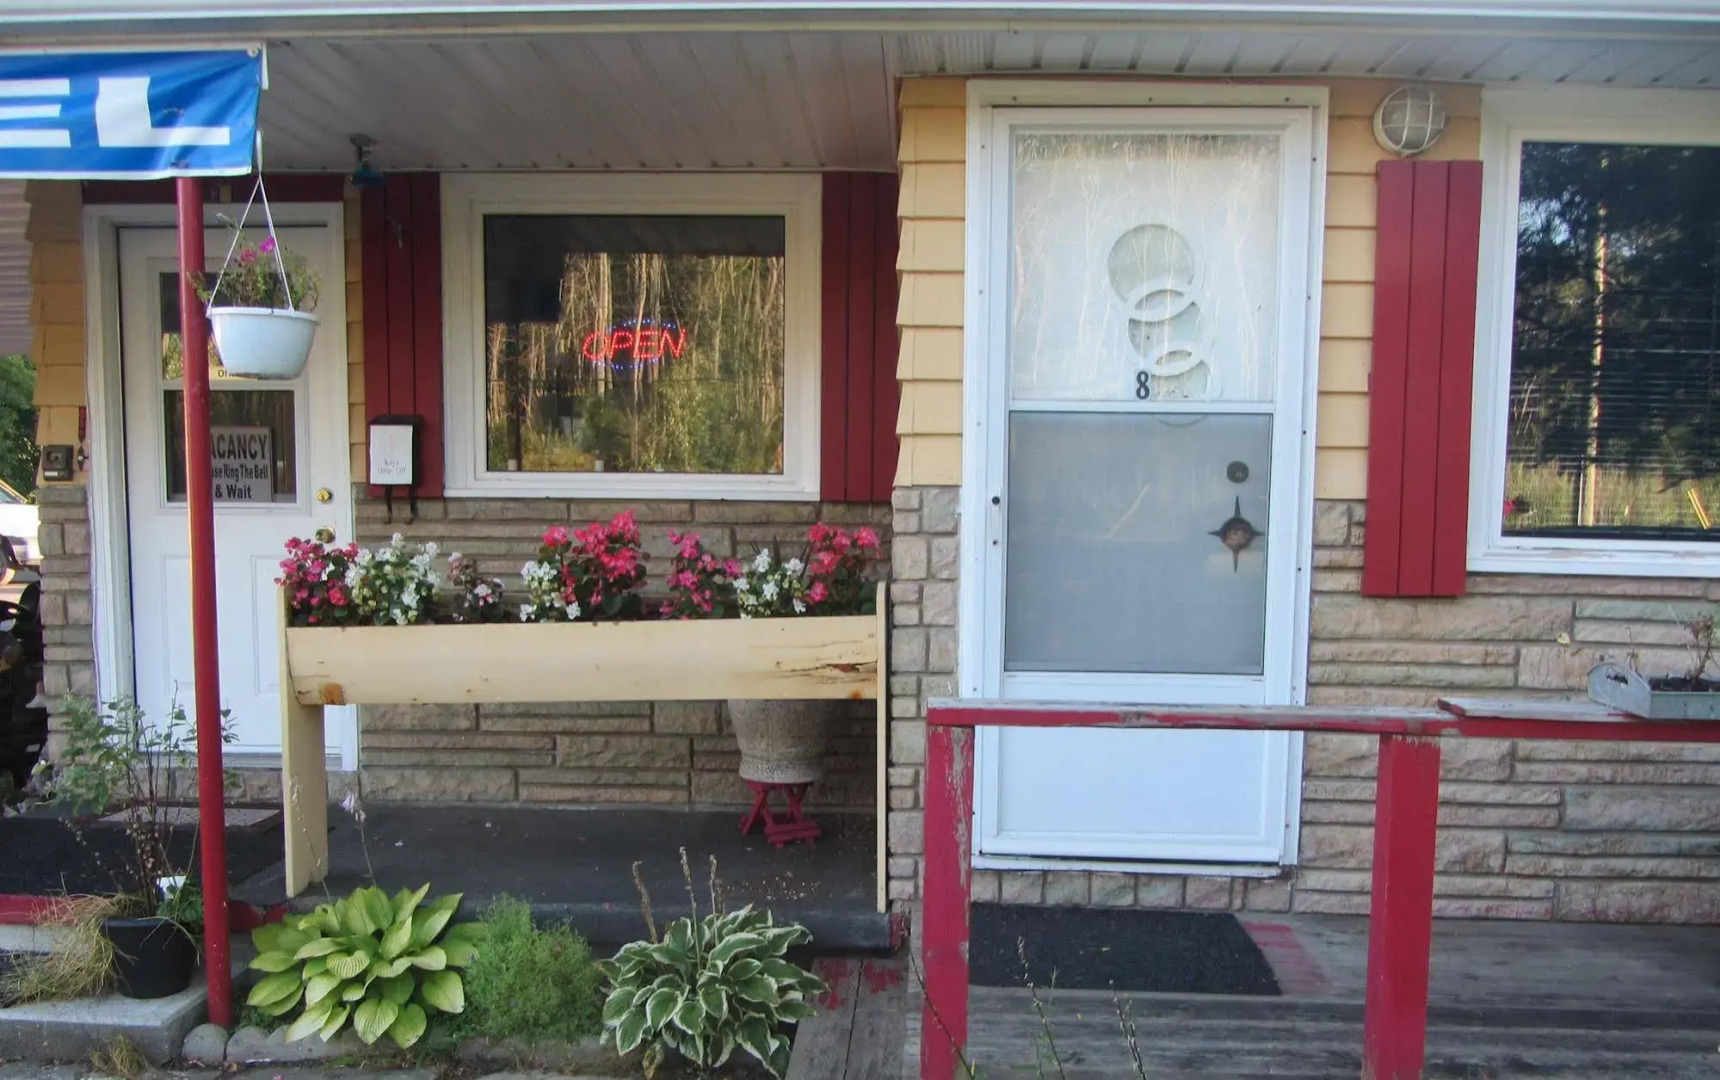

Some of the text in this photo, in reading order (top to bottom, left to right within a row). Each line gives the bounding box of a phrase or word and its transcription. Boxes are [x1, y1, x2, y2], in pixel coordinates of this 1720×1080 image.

[582, 328, 688, 360] OPEN
[1136, 370, 1150, 400] 8
[223, 464, 240, 483] Ring
[240, 464, 254, 479] The
[254, 464, 269, 480] Bell
[215, 483, 252, 500] & Wait
